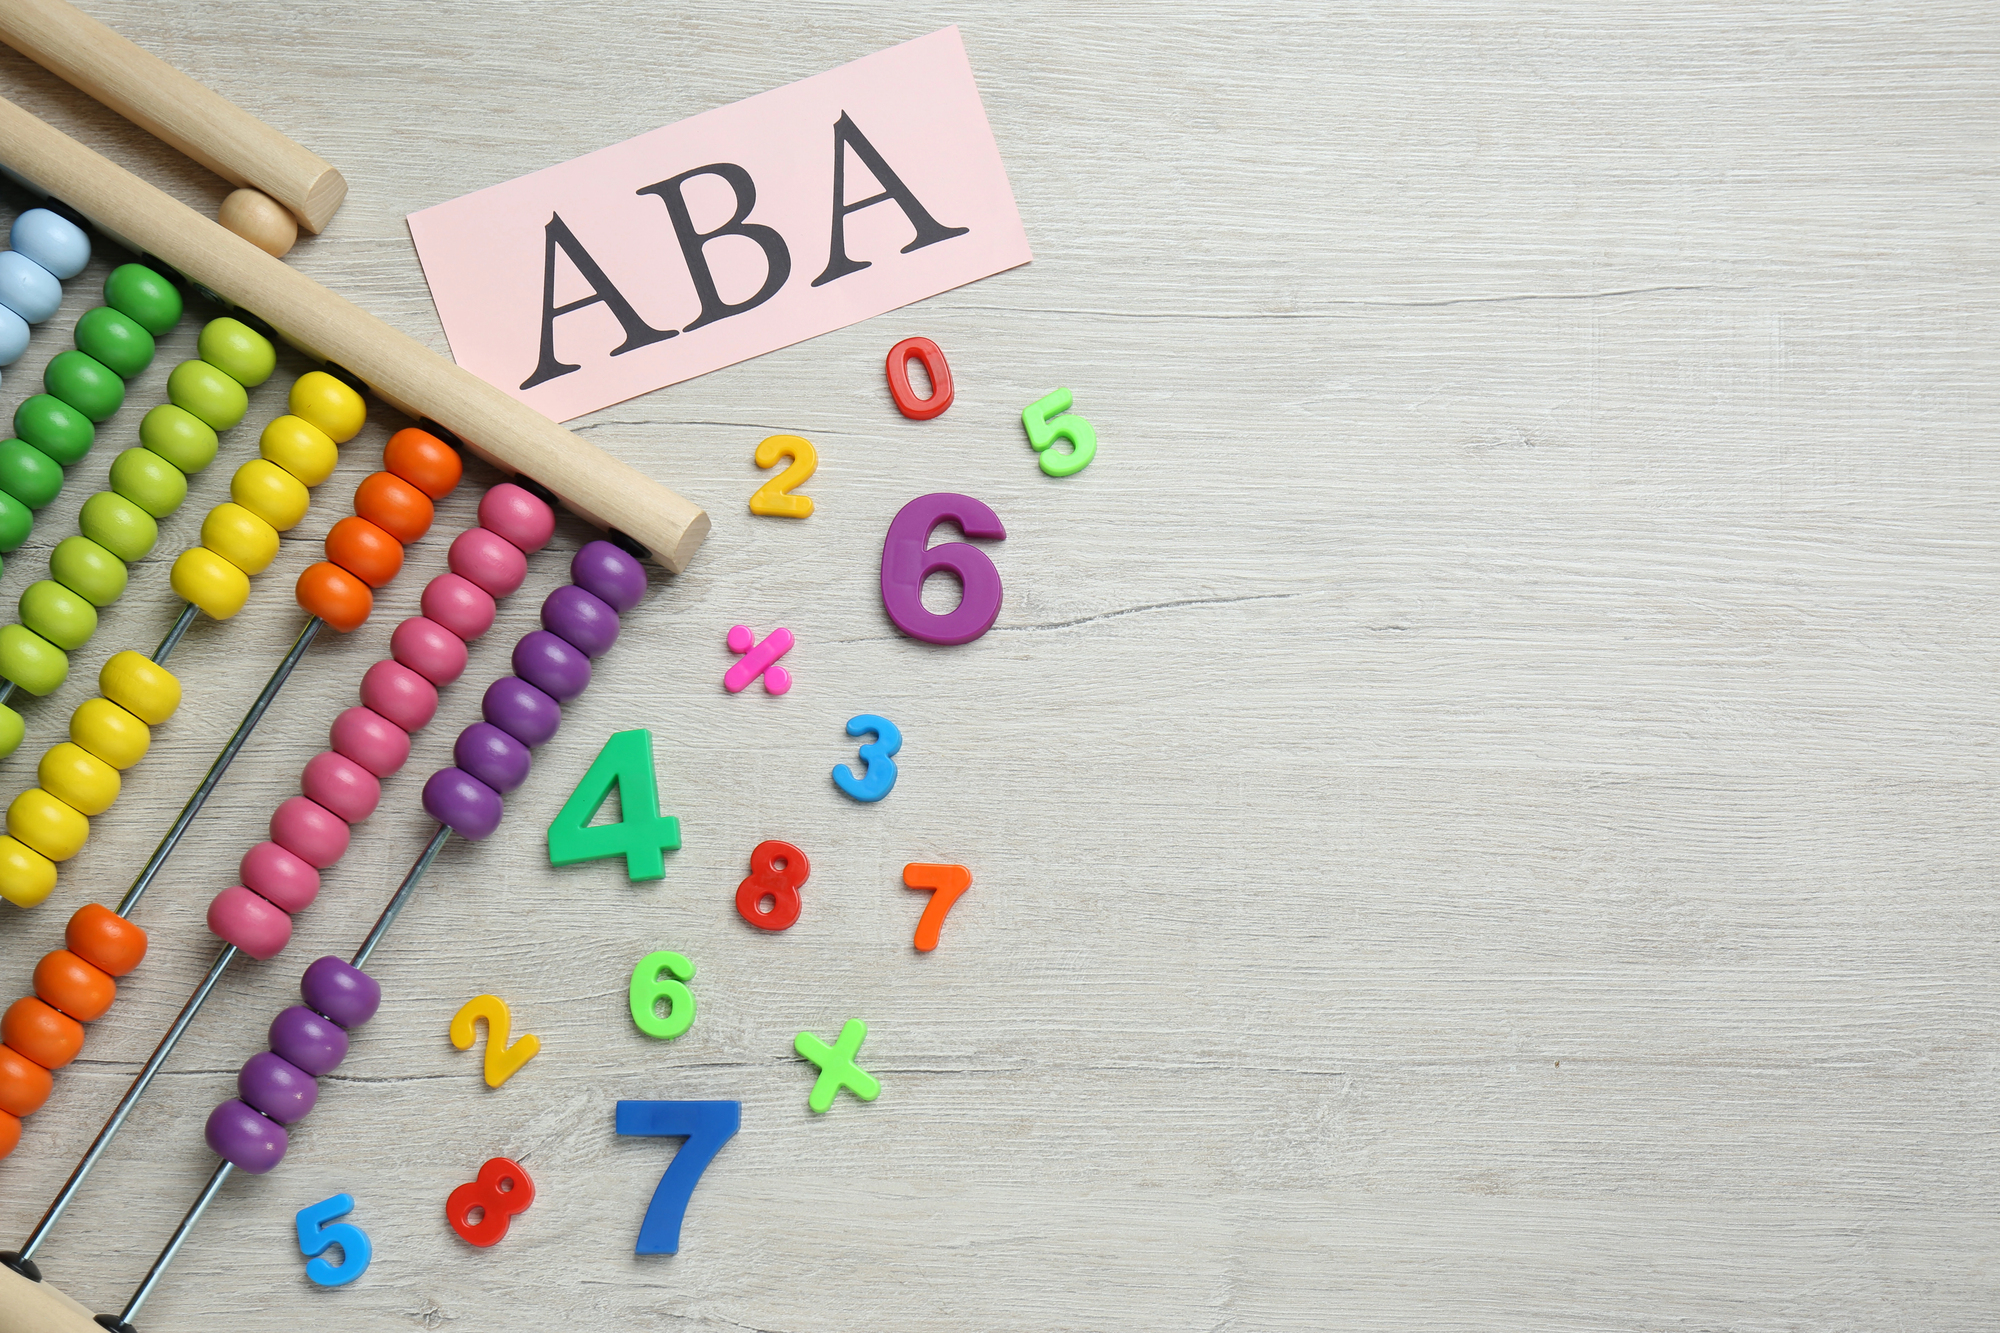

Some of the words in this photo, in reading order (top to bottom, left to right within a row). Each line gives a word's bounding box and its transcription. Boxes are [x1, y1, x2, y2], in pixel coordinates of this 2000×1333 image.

[520, 110, 969, 390] ABA
[749, 434, 818, 519] 2
[1021, 387, 1098, 478] 5
[881, 492, 1006, 646] 6
[832, 714, 903, 803] 3
[548, 729, 682, 882] 4
[735, 839, 811, 932] 8
[902, 863, 973, 952] 7
[449, 994, 542, 1089] 2
[629, 950, 697, 1040] 6
[446, 1156, 536, 1248] 8
[616, 1100, 742, 1256] 7
[296, 1193, 373, 1288] 5
